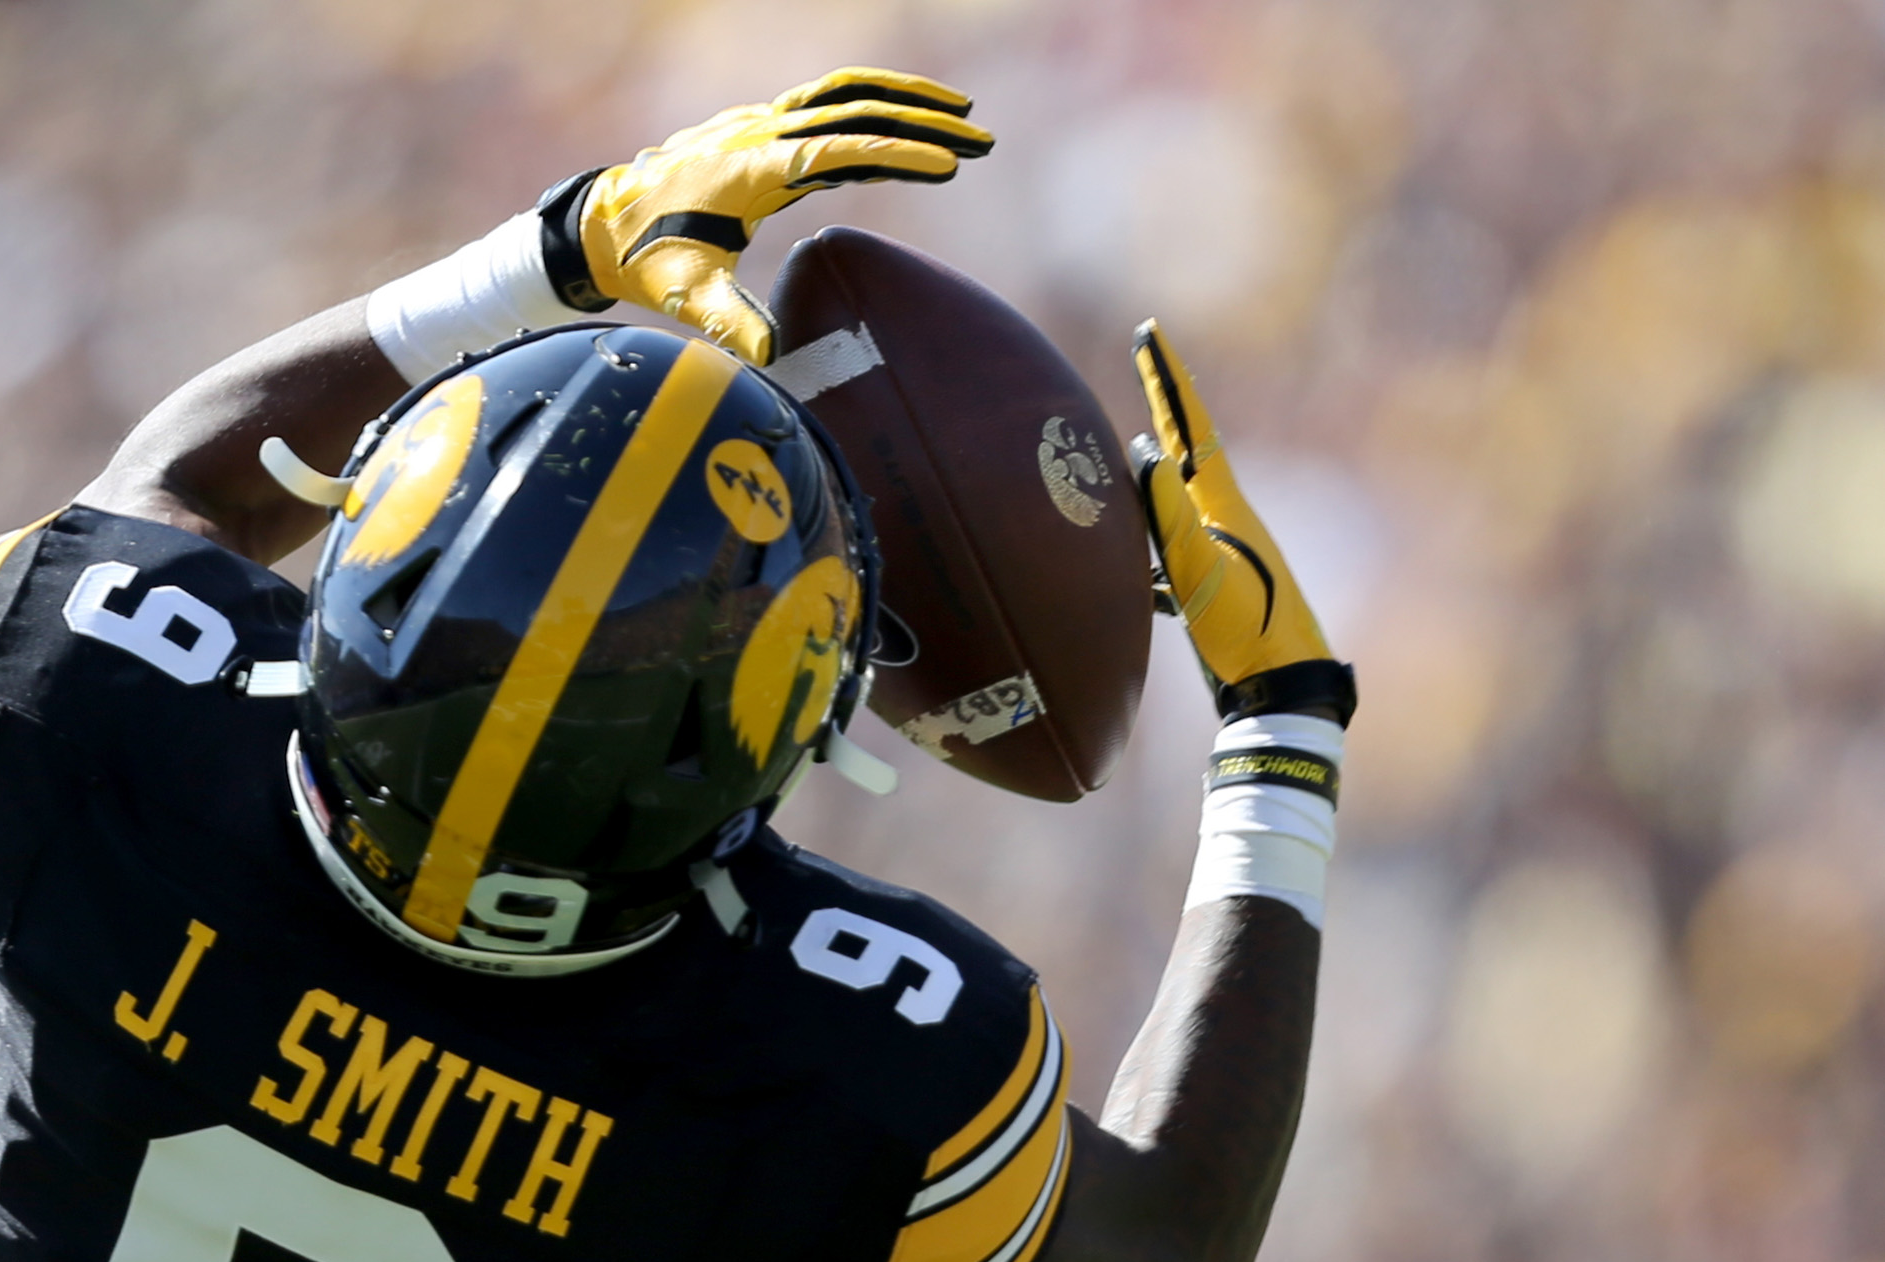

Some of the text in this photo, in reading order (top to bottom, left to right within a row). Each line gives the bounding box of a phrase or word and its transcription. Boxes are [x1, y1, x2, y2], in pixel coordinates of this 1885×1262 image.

[712, 459, 786, 520] ANF
[1084, 431, 1115, 487] IOWA
[61, 560, 238, 687] 9
[457, 871, 590, 953] 9
[789, 907, 964, 1025] 9
[115, 918, 615, 1238] J. SMITH
